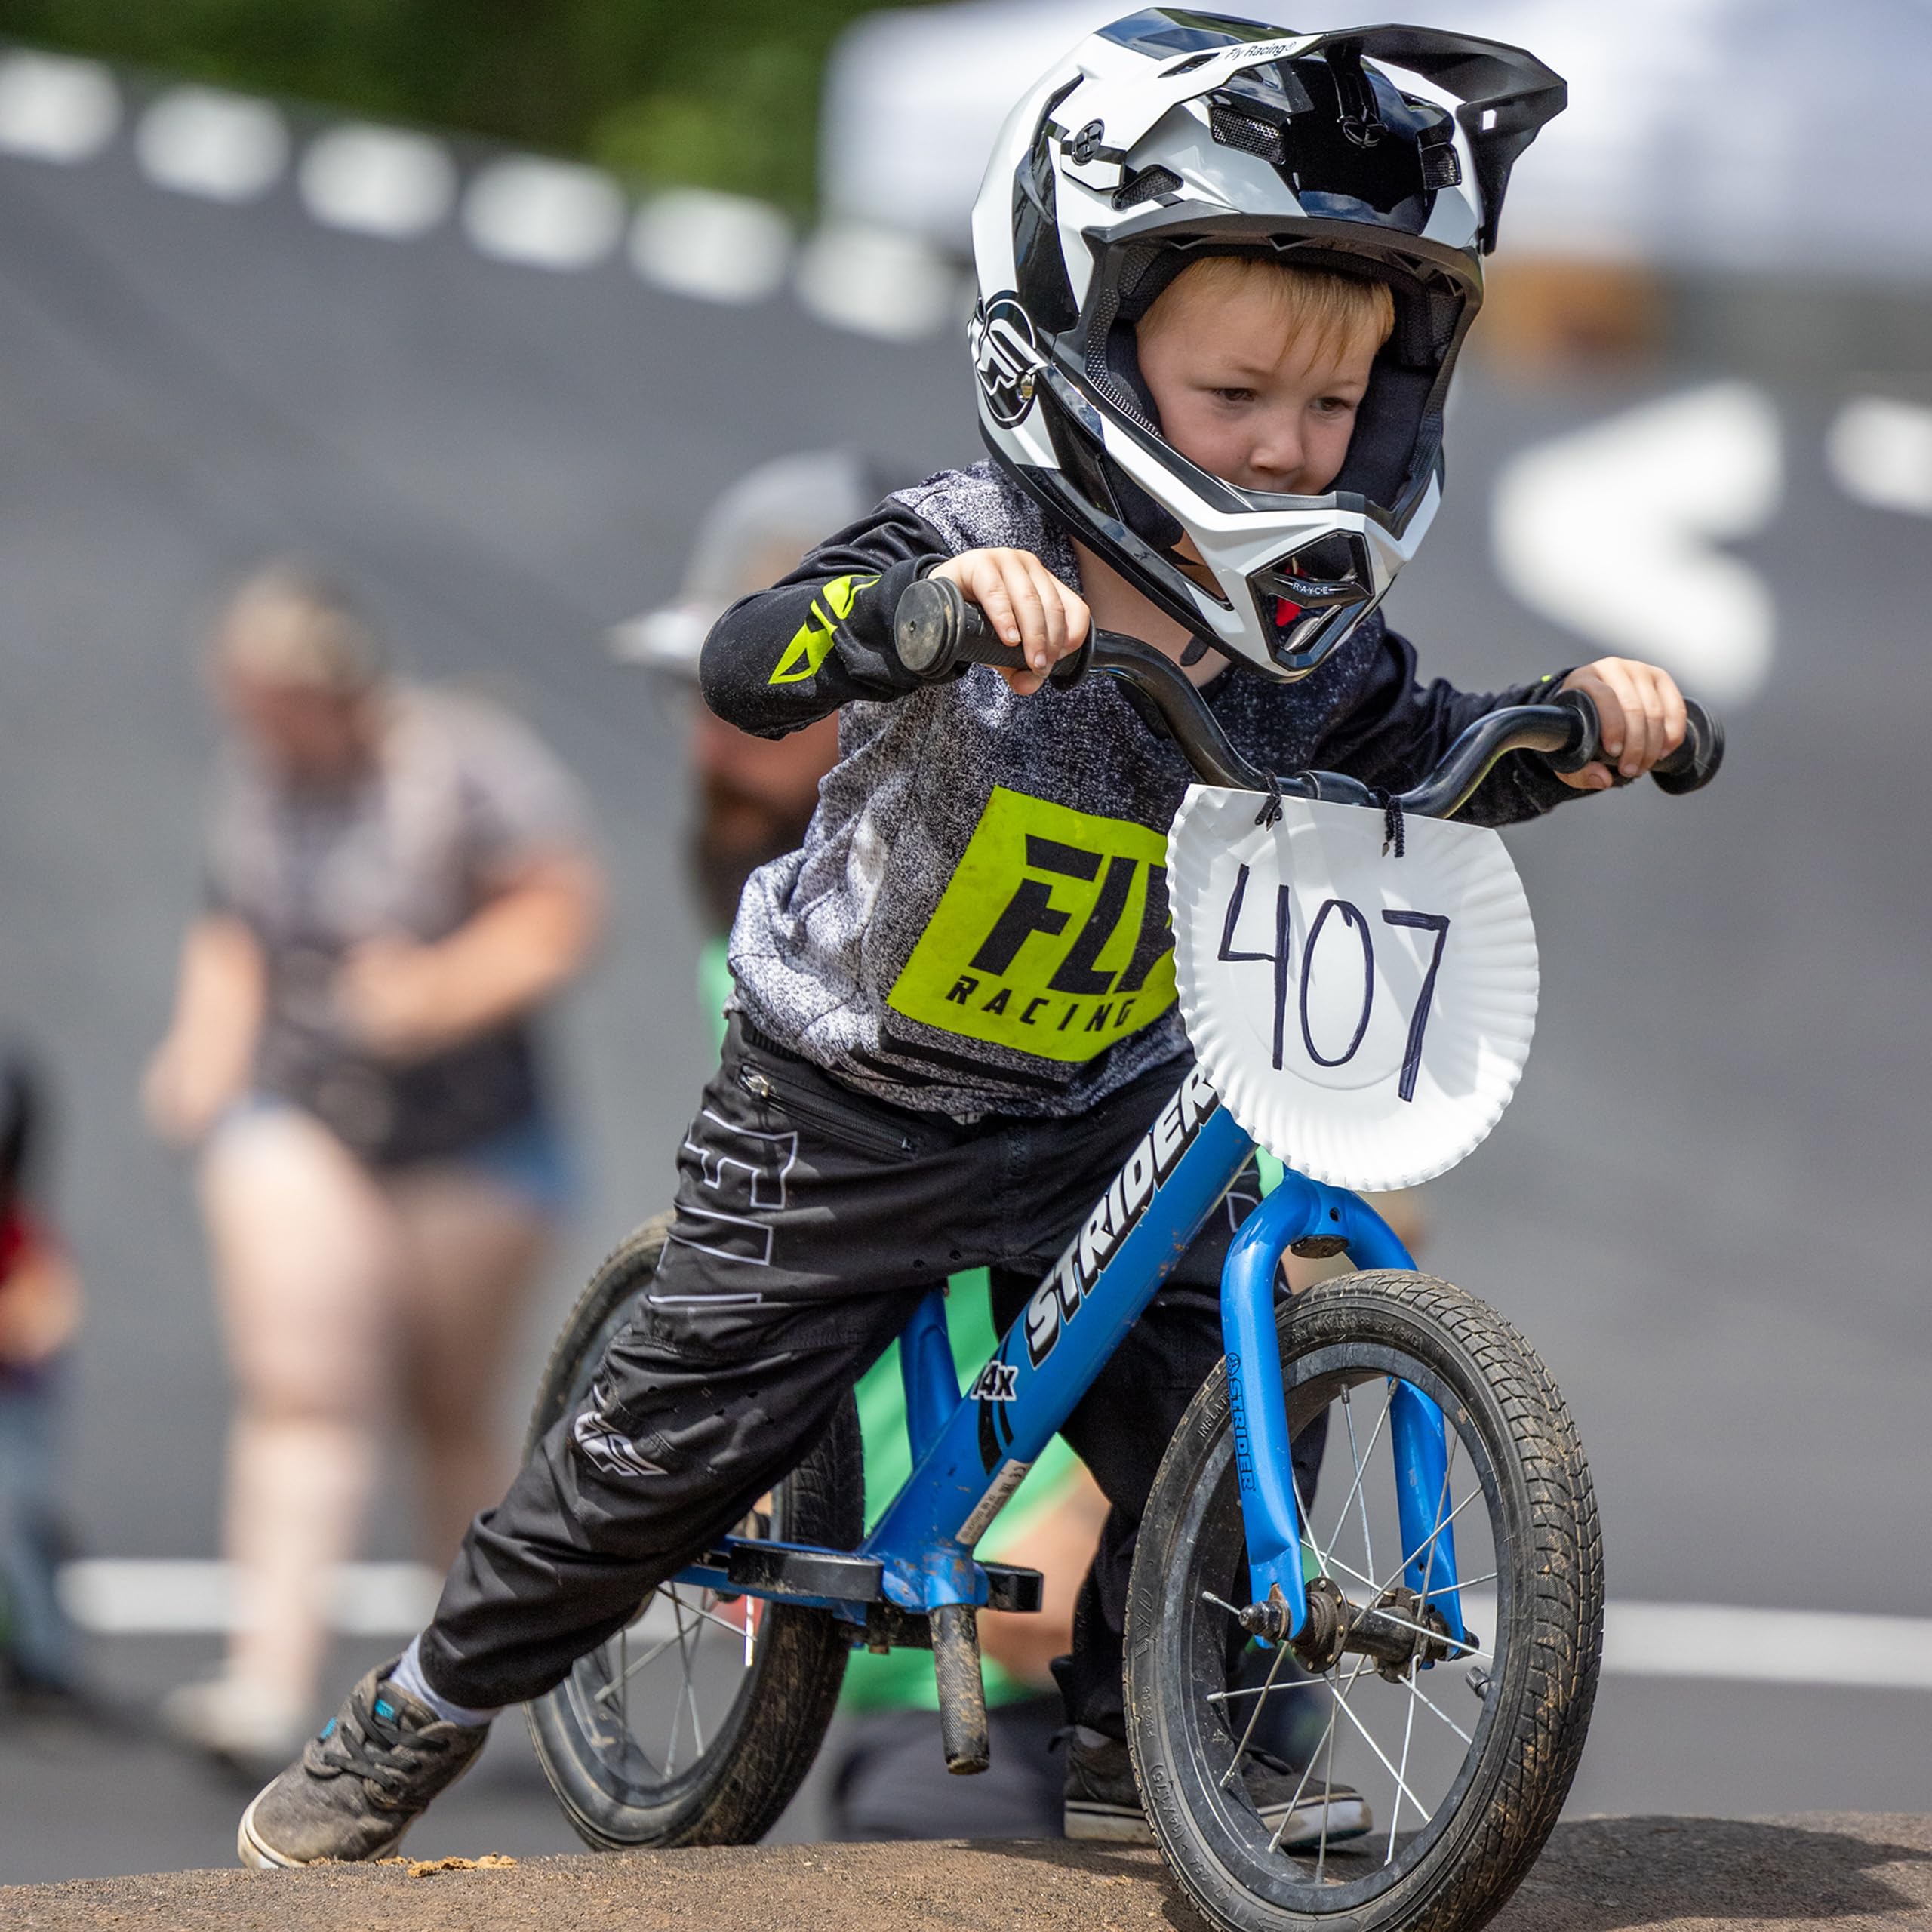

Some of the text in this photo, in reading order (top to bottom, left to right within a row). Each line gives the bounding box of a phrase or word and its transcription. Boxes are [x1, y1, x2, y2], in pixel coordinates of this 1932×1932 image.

[1224, 48, 1244, 60] Fly
[945, 974, 1137, 1032] RACING
[1217, 863, 1451, 1103] 407
[1026, 1062, 1220, 1366] STRIDER
[1229, 1378, 1255, 1491] STRIDER
